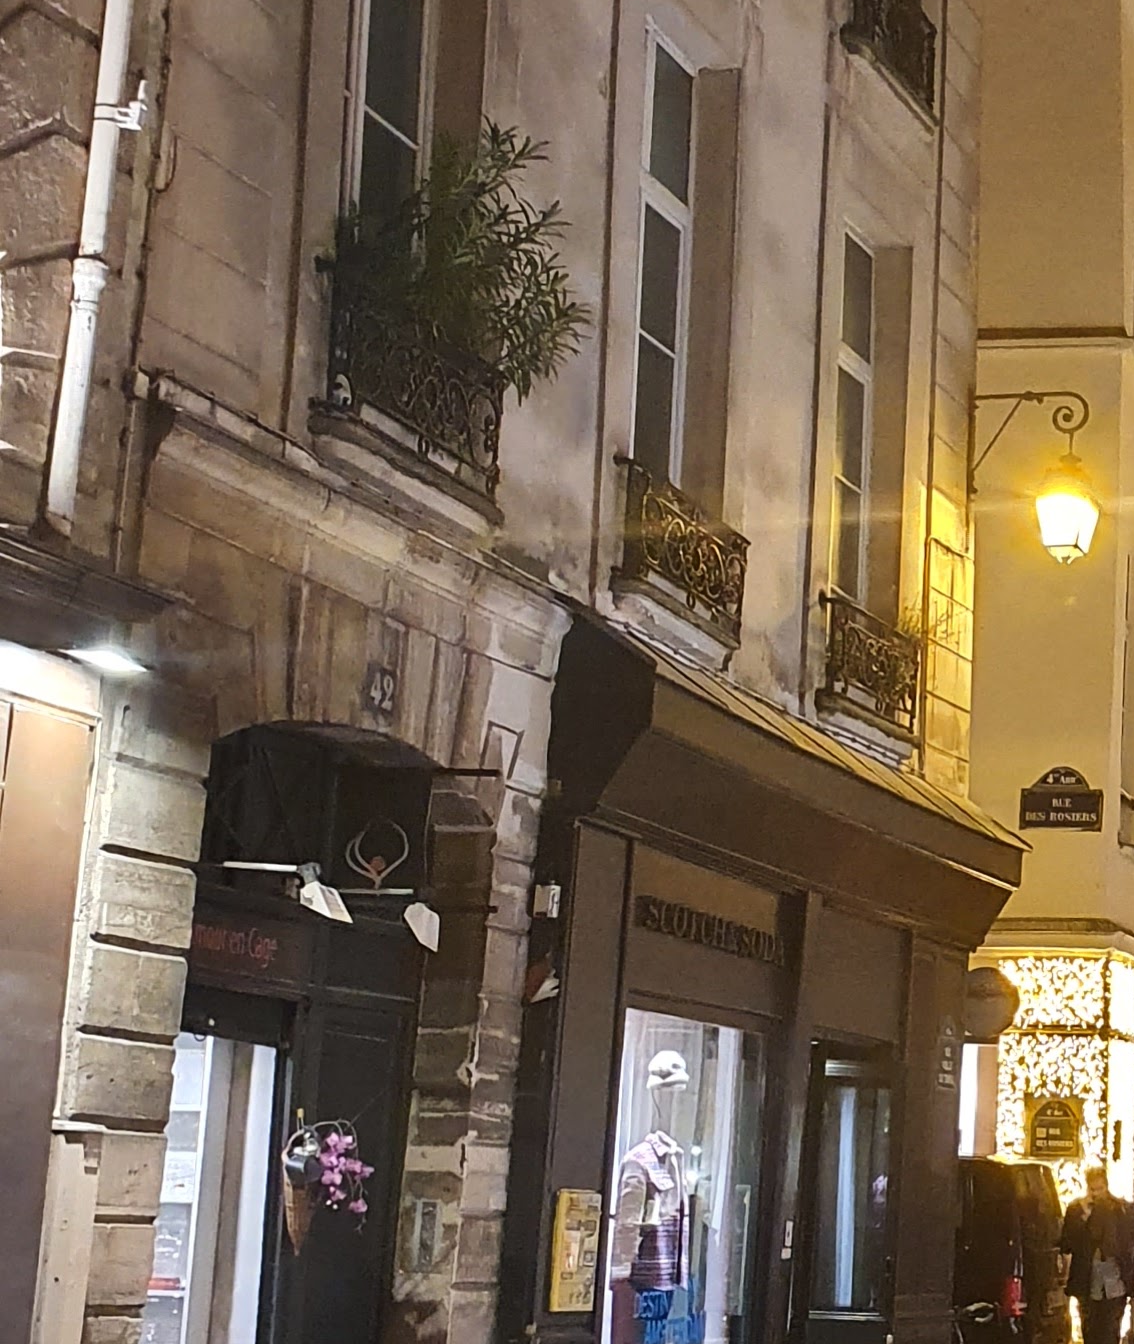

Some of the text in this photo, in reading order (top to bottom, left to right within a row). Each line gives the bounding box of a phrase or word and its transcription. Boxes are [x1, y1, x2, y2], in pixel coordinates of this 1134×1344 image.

[369, 672, 394, 711] 42
[1025, 811, 1097, 822] DES ROSIERS
[1052, 798, 1072, 808] RUE
[646, 904, 726, 948] SCOTCH
[192, 923, 225, 951] mour
[248, 927, 279, 969] Cage
